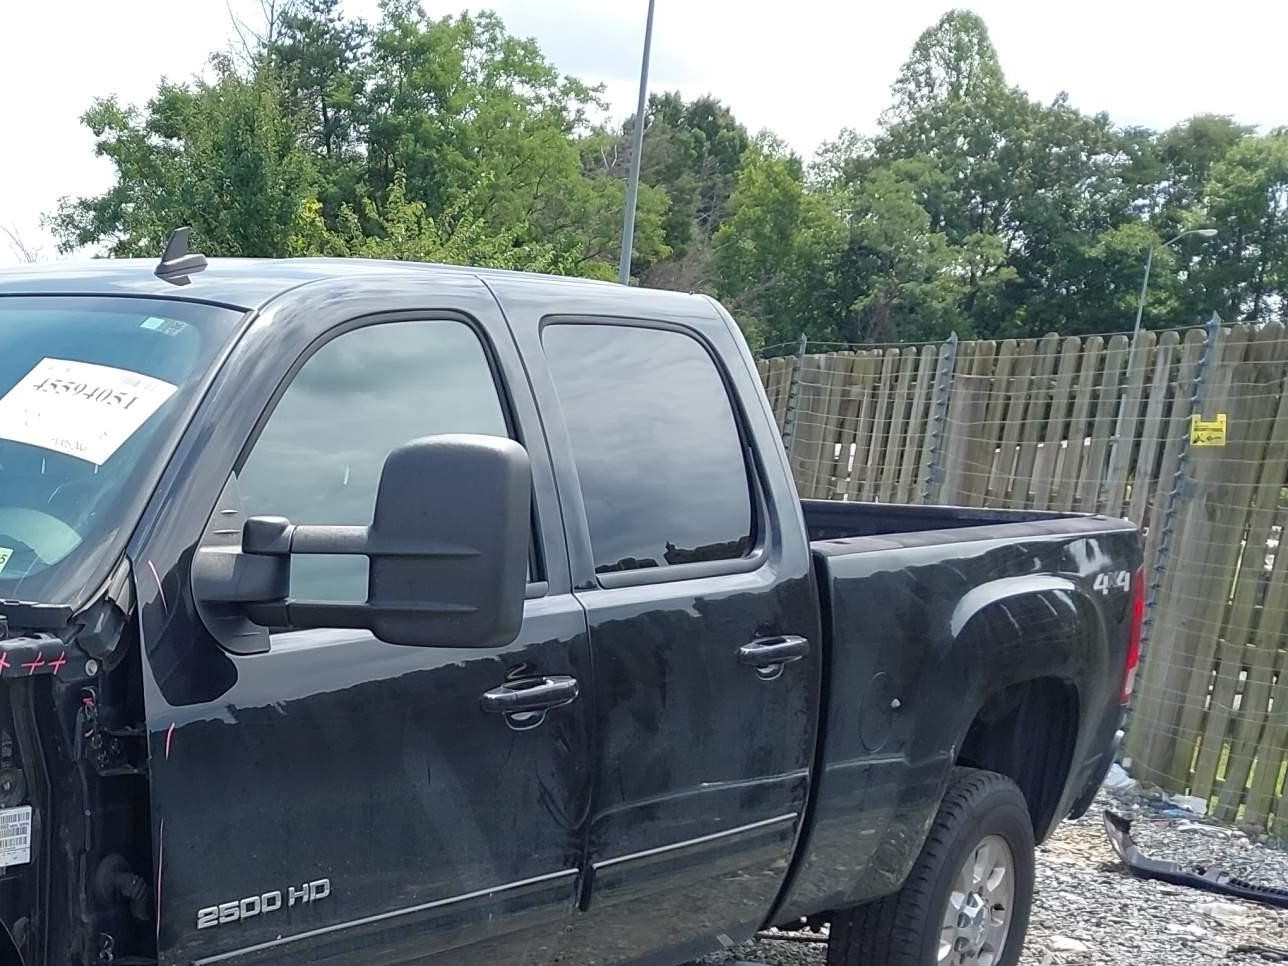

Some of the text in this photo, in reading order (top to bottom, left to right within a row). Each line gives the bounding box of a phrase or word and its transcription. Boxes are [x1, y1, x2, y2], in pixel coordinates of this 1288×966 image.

[33, 377, 139, 410] 45594051
[197, 878, 331, 929] 2500 HD
